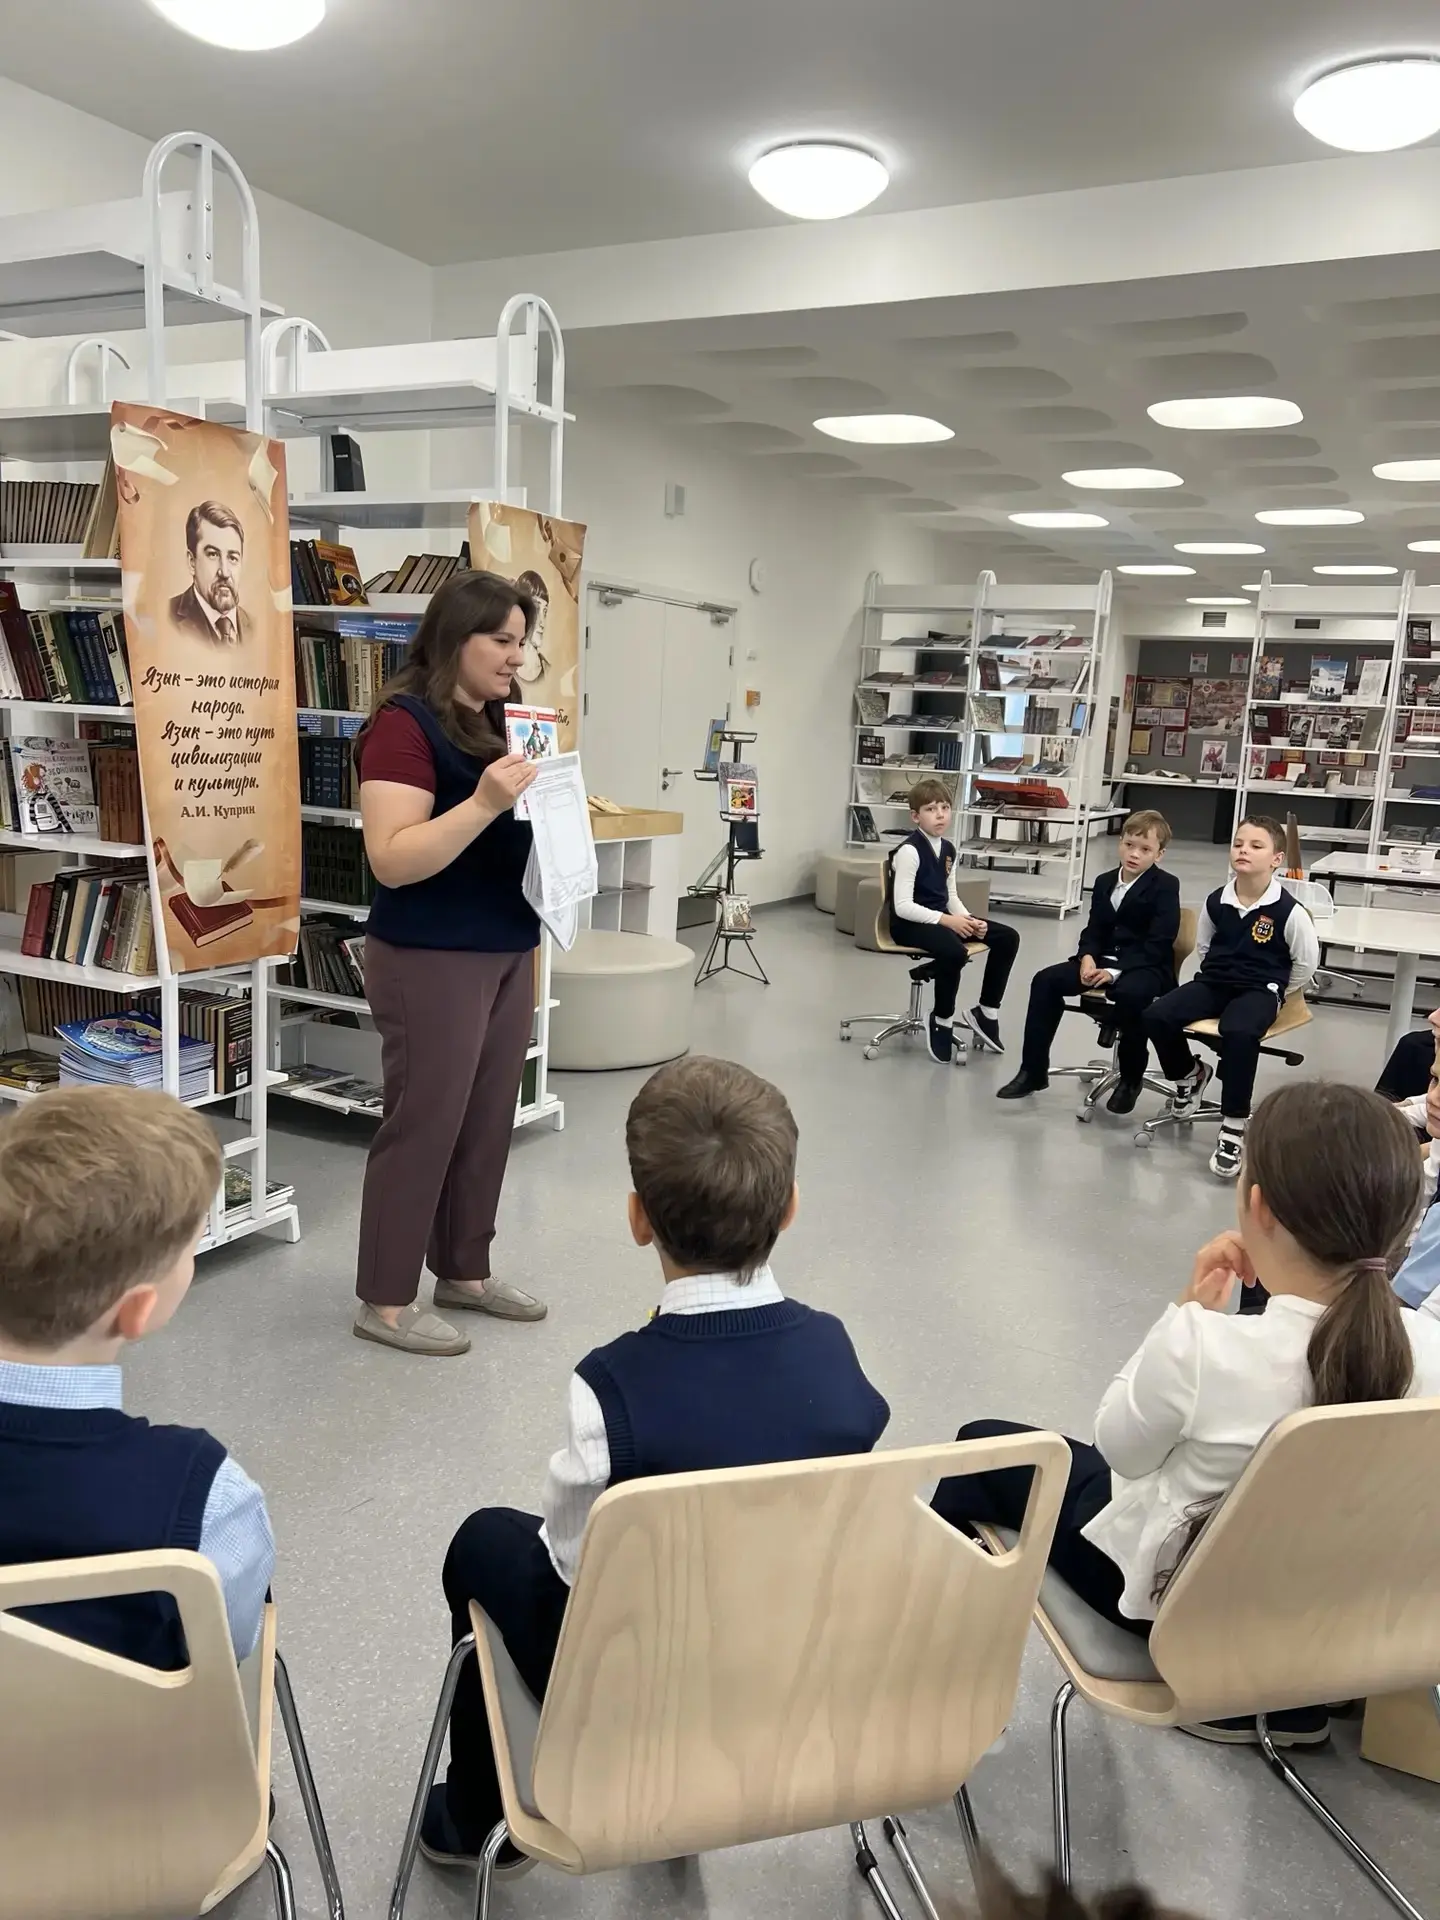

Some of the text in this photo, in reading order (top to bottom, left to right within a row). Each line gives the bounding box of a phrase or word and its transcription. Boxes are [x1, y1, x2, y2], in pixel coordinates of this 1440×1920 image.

[141, 666, 181, 692] Язык
[196, 674, 226, 688] это
[229, 675, 280, 696] история
[191, 699, 245, 721] народа.
[161, 720, 200, 746] Язык
[216, 727, 242, 740] это
[245, 726, 275, 746] путь
[171, 745, 262, 772] цивилизации
[174, 775, 260, 798] и культуры.
[180, 804, 256, 820] А.И. Куприн
